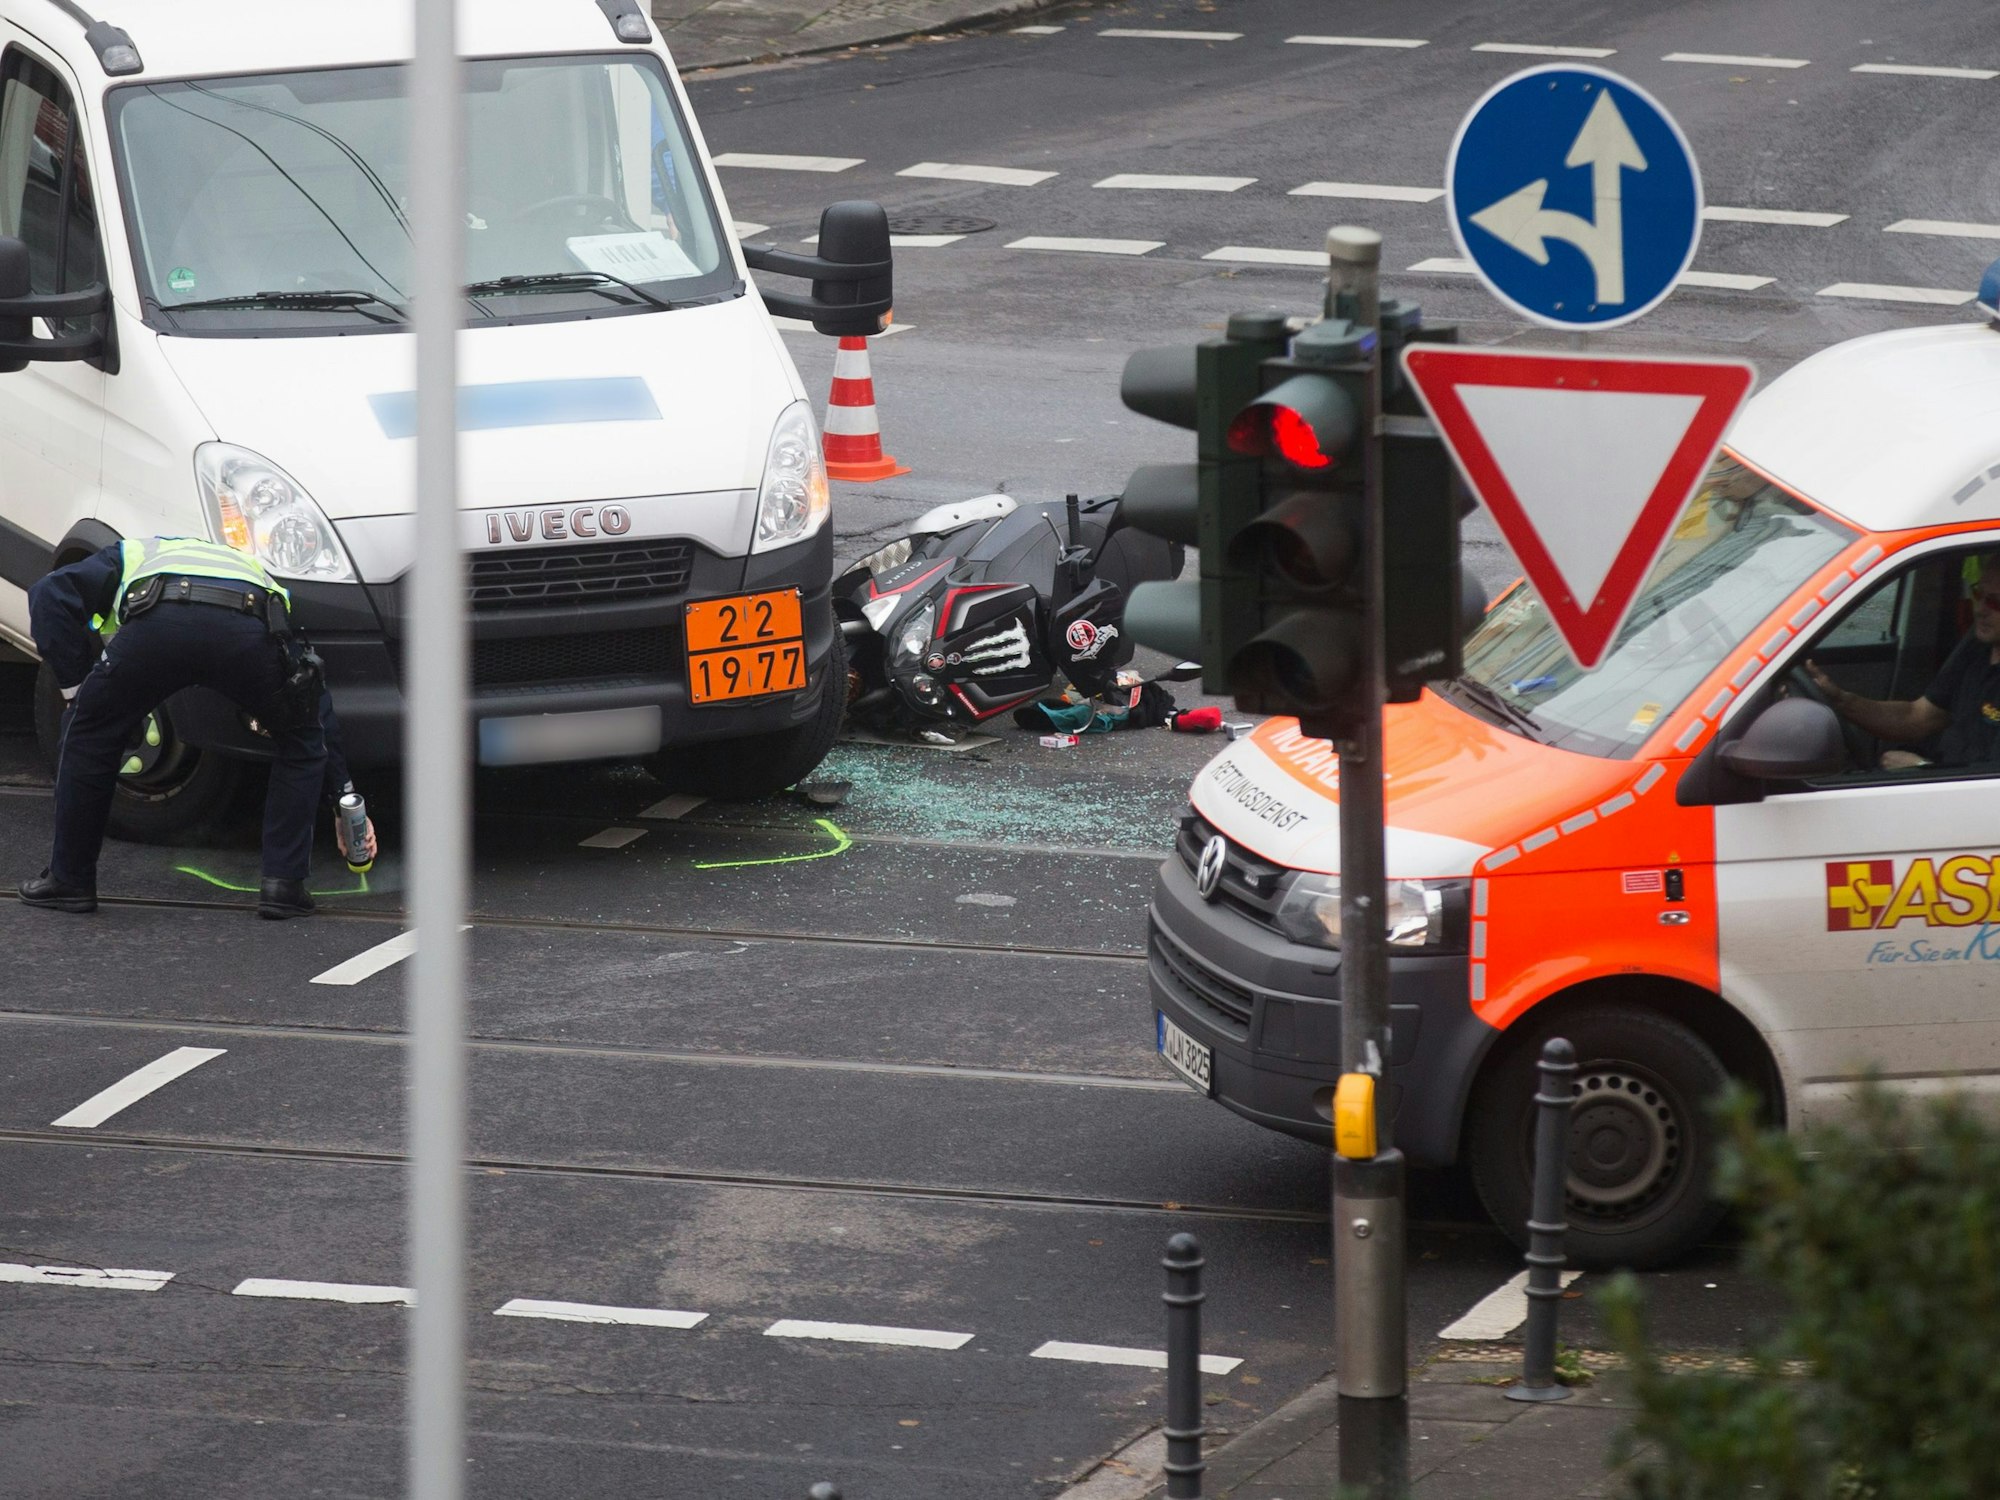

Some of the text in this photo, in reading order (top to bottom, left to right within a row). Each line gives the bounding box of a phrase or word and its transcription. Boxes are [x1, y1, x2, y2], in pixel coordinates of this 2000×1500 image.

[486, 505, 631, 543] IVECO
[698, 647, 801, 697] 1977
[1210, 760, 1308, 832] RETTUNGSDIENST
[1866, 941, 1904, 964] Für
[1905, 940, 1939, 963] Sie
[1964, 922, 2000, 961] K
[1186, 1039, 1210, 1083] 3825
